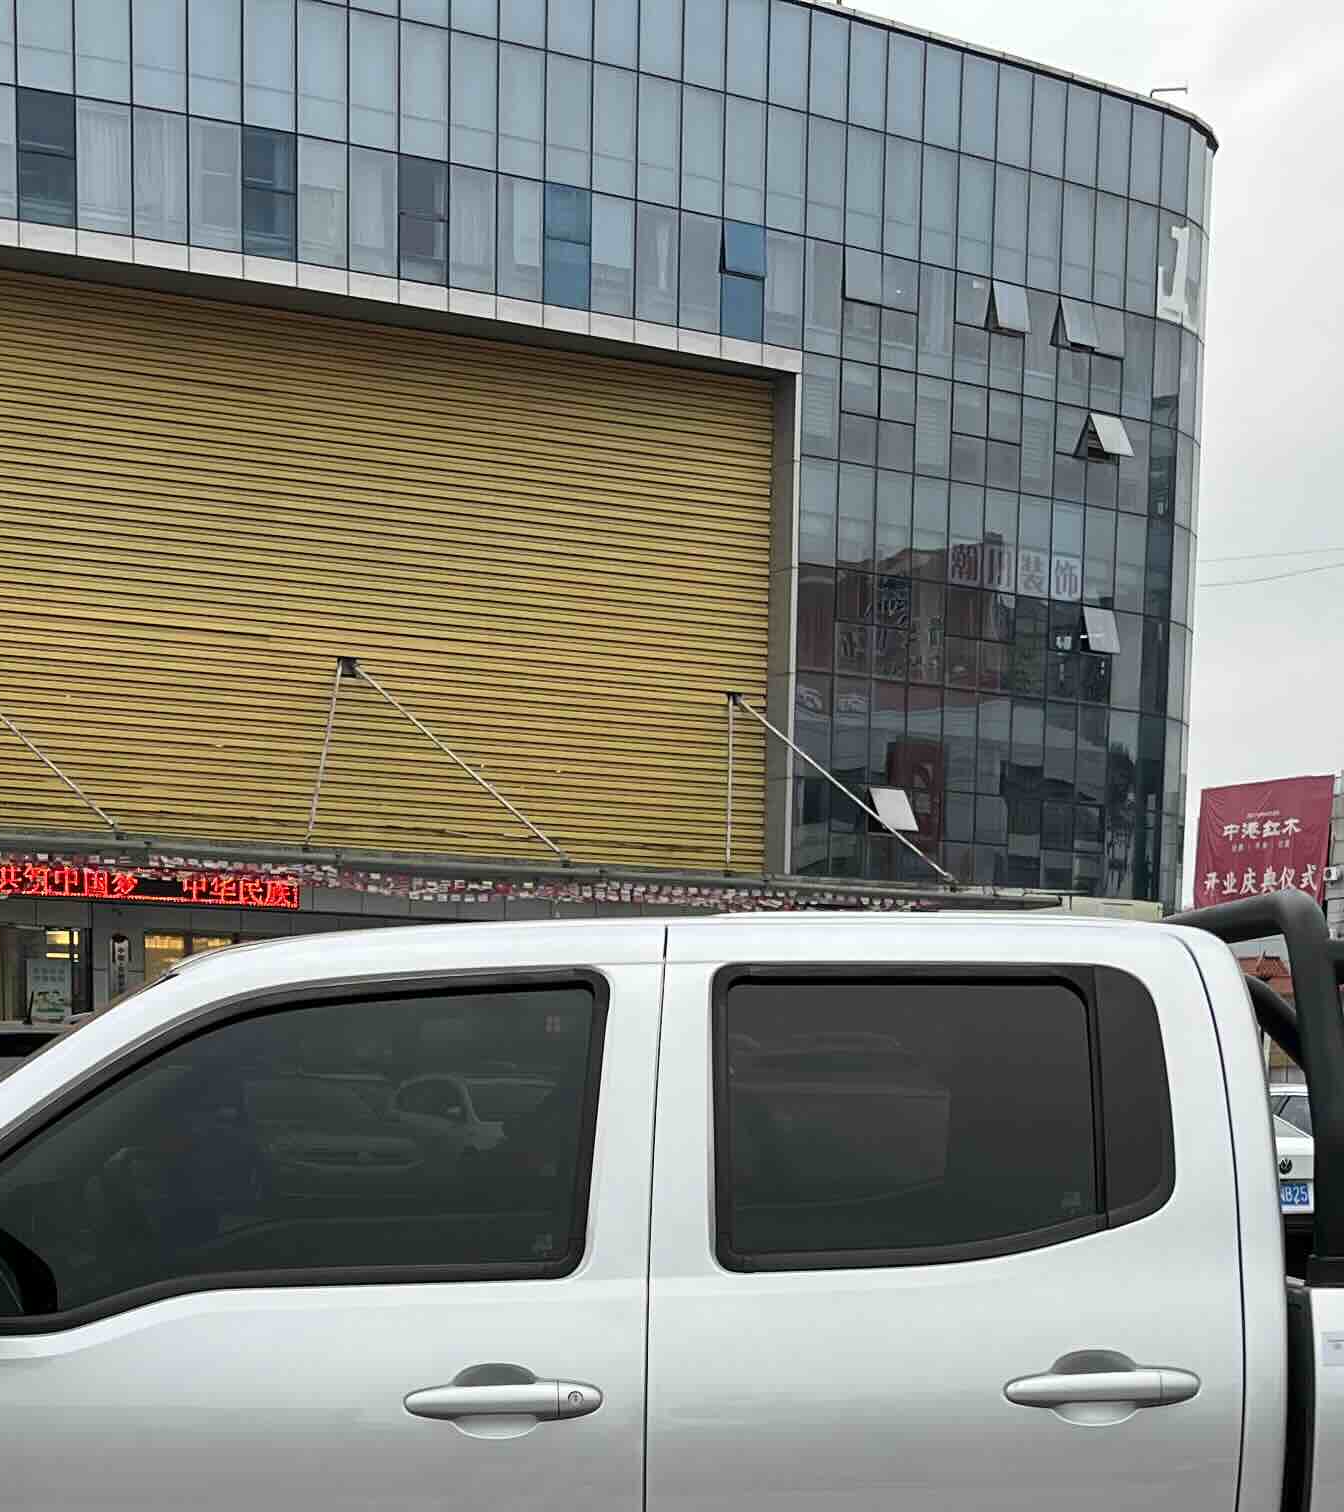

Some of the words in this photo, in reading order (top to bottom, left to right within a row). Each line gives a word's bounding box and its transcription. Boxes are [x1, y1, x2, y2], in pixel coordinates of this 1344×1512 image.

[182, 876, 292, 905] 中华民族
[1204, 864, 1317, 896] 开业庆典仪式
